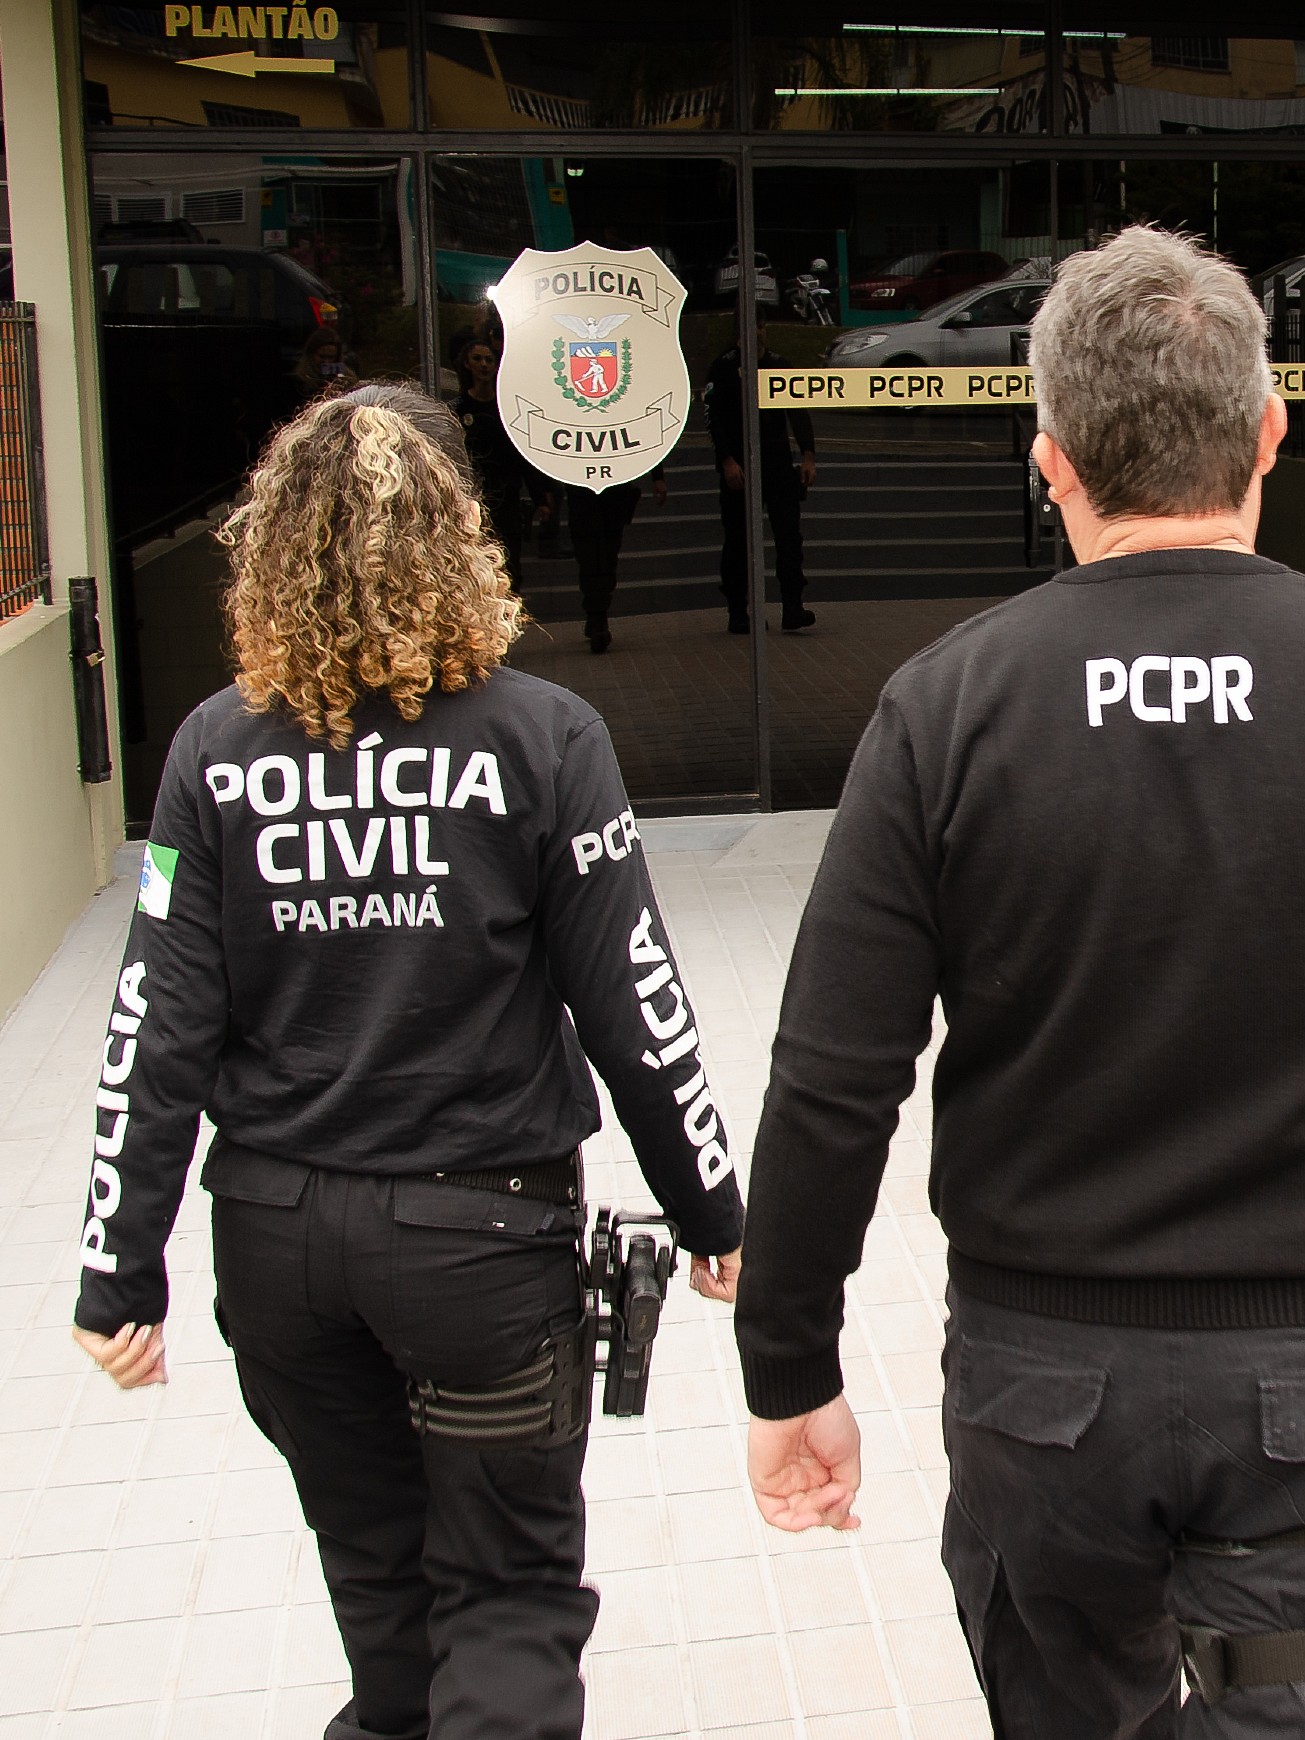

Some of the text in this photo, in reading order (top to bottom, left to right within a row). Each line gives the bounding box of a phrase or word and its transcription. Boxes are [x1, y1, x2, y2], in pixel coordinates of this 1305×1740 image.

[165, 0, 338, 40] PLANTÃO
[534, 265, 645, 301] POLÍCIA
[769, 376, 845, 399] PCPR
[869, 375, 944, 398] PCPR
[551, 427, 641, 452] CIVIL
[586, 465, 614, 479] PR
[1085, 654, 1255, 728] PCPR
[205, 731, 508, 817] POLÍCIA
[256, 815, 450, 884] CIVIL
[271, 884, 445, 932] PARANÁ
[629, 906, 734, 1192] POLÍCIA
